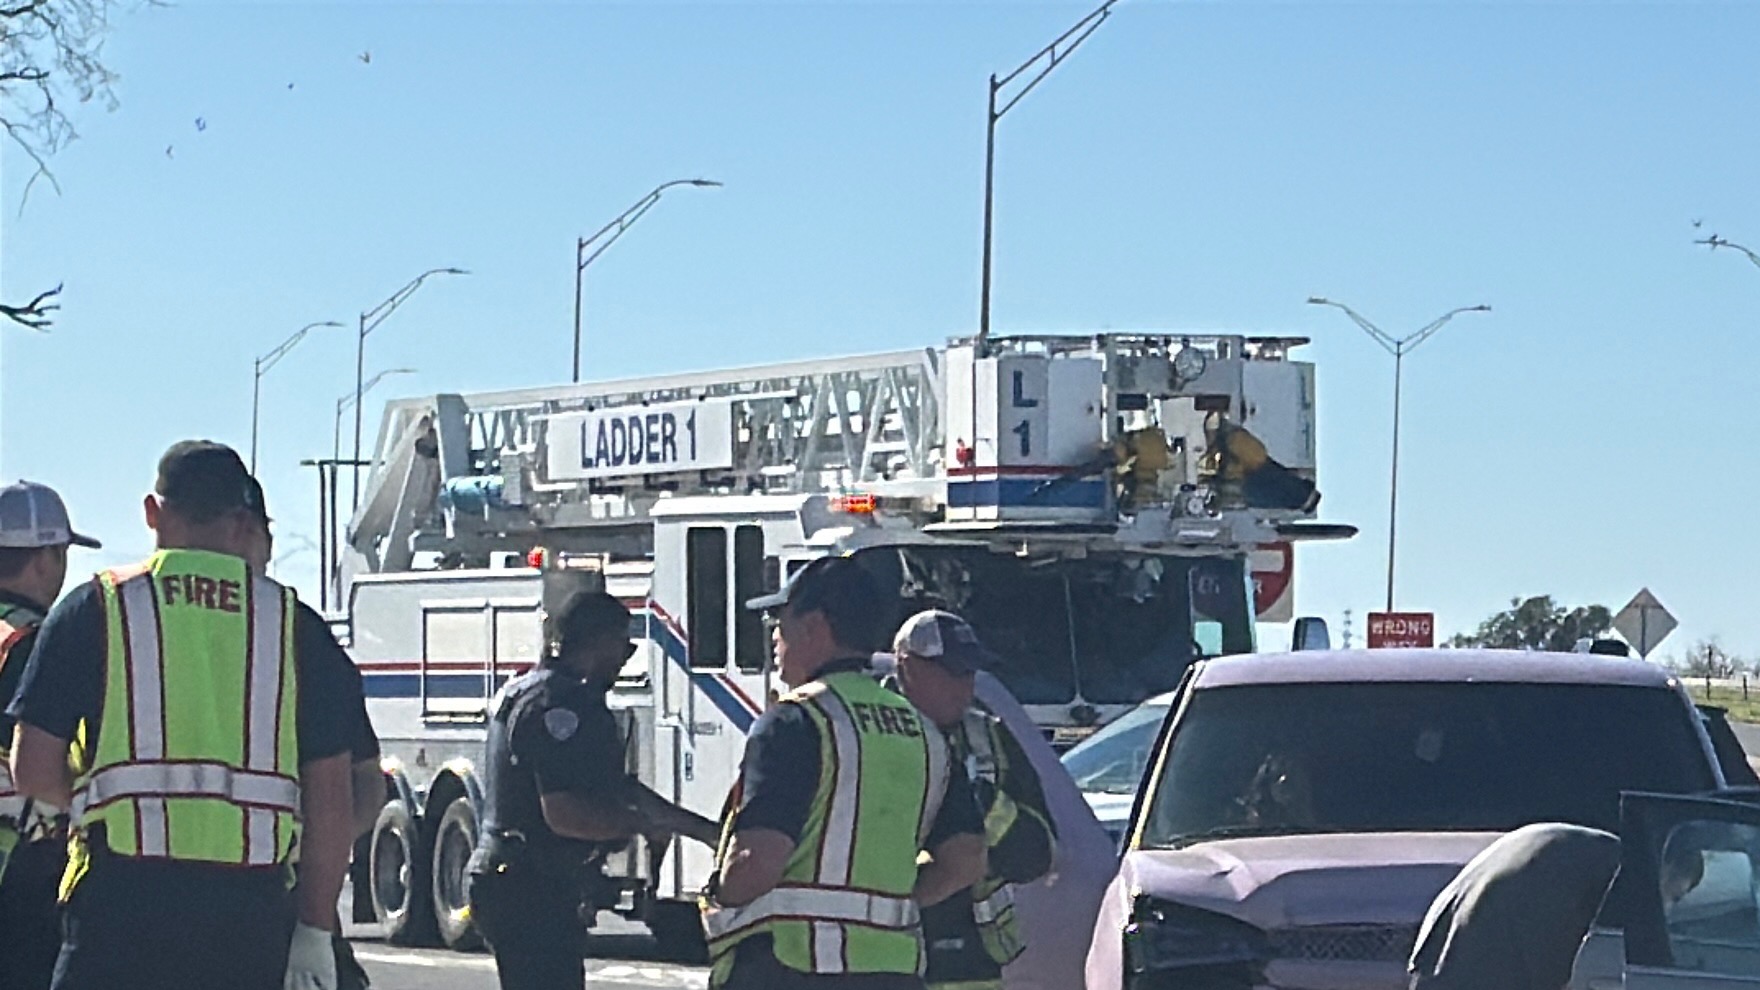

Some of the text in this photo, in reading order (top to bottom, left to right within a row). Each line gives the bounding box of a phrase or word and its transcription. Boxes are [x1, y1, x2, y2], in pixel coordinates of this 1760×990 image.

[1013, 370, 1038, 407] L
[581, 406, 696, 469] LADDER 1
[1013, 419, 1030, 456] 1
[162, 574, 241, 613] FIRE
[1372, 619, 1430, 636] WRONG
[852, 702, 921, 738] FIRE
